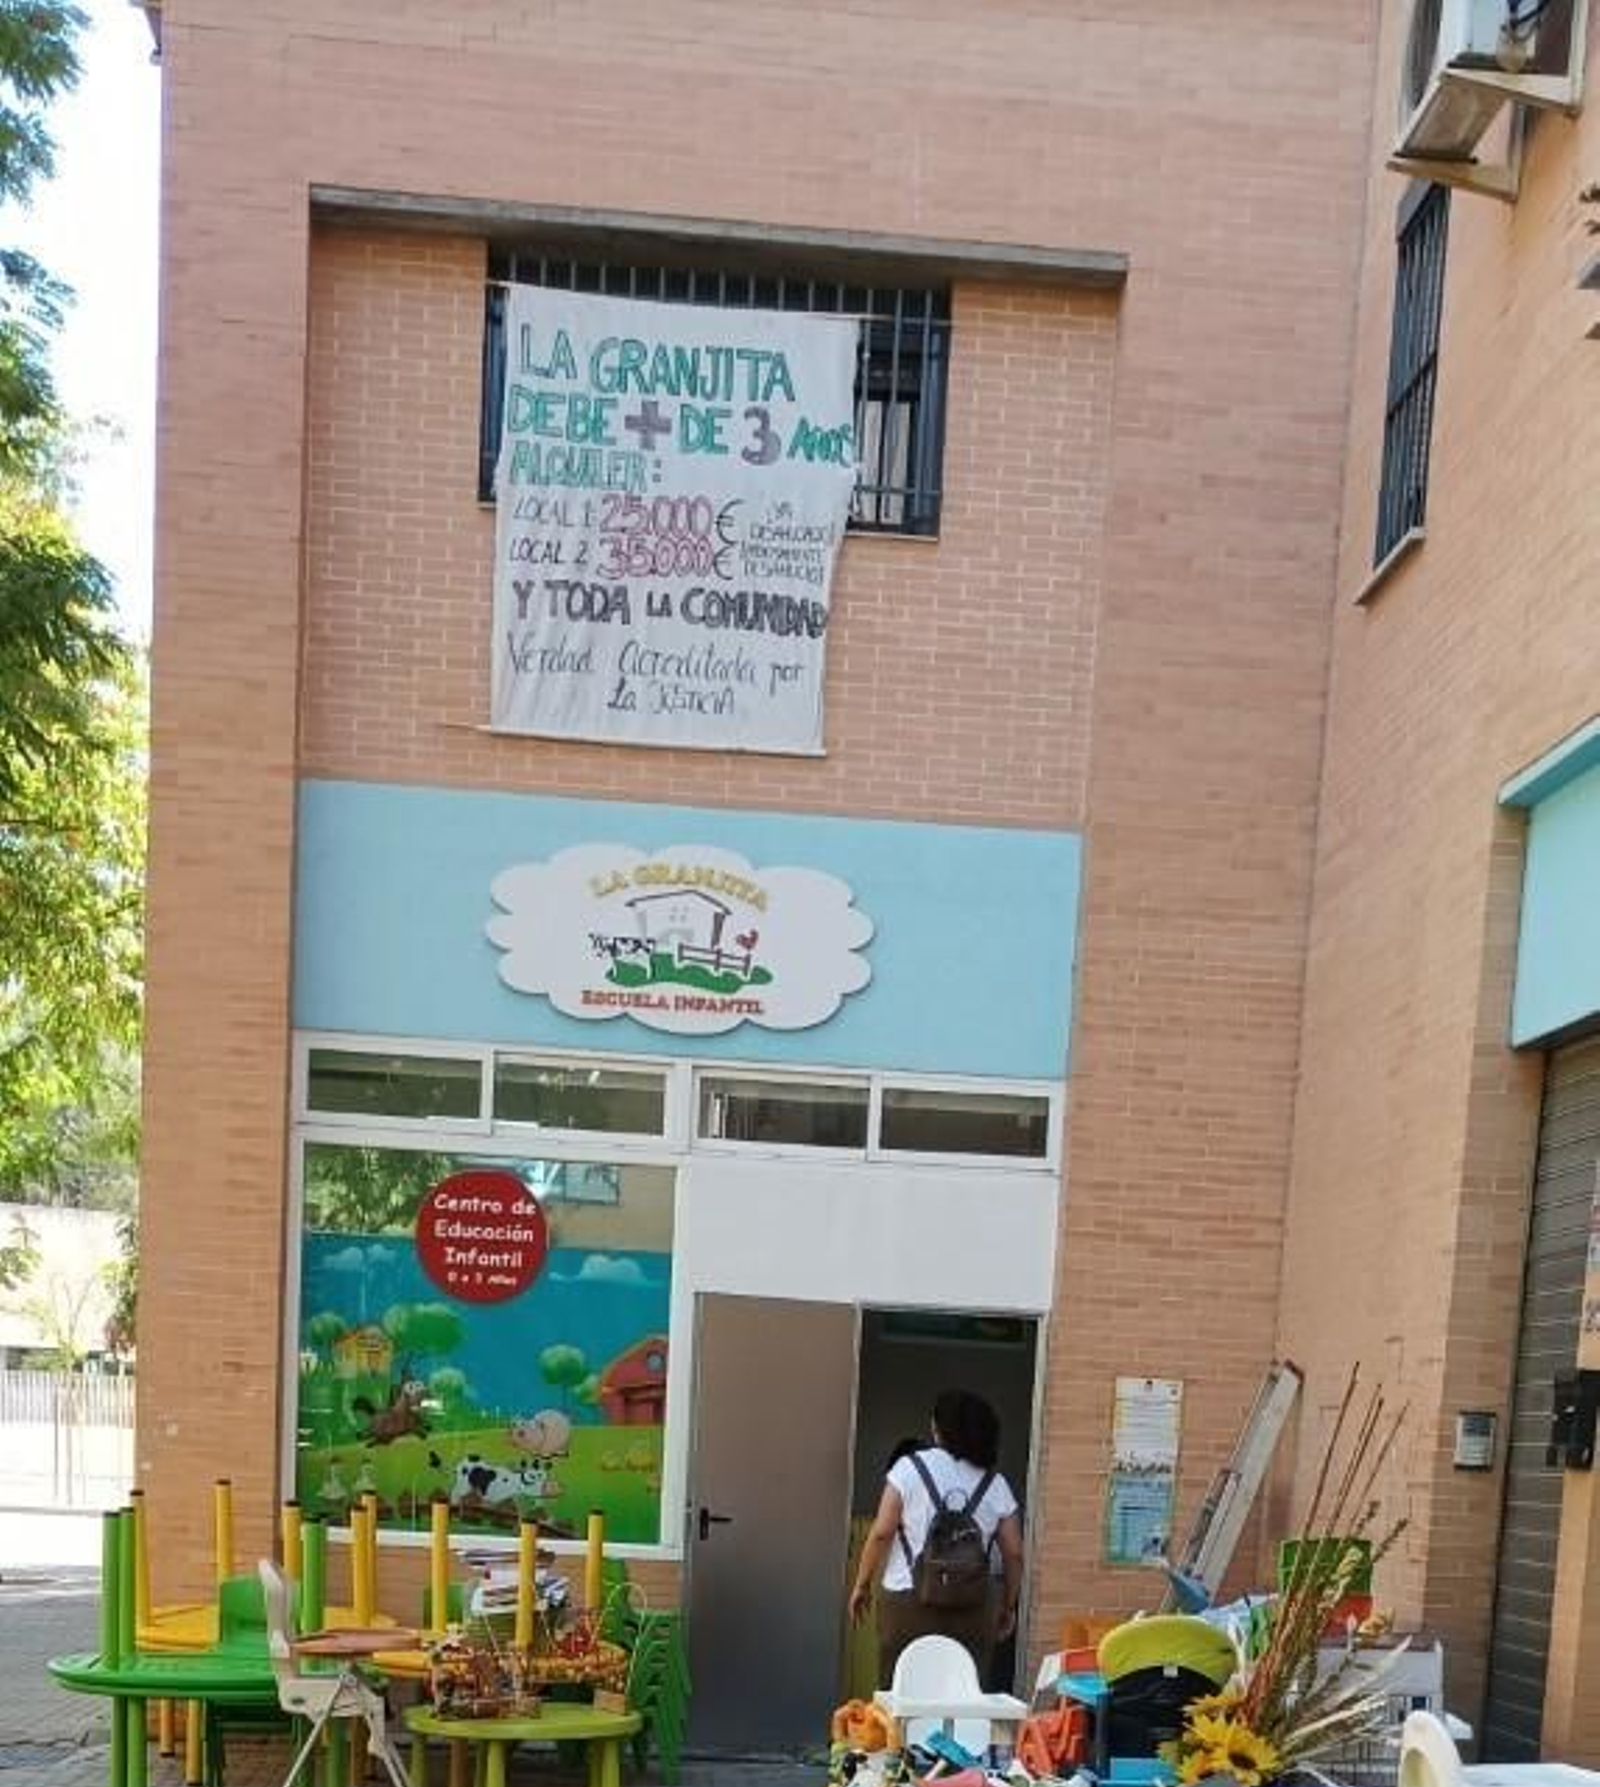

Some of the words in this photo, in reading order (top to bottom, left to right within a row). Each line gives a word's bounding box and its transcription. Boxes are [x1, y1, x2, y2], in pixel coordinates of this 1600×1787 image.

[520, 323, 578, 380] LA
[589, 336, 797, 402] GRANJITA
[506, 385, 620, 447] DEBE
[624, 400, 673, 451] +
[679, 404, 734, 455] DE
[741, 406, 782, 466] 3
[512, 496, 575, 528] LOCAL
[509, 536, 567, 565] LOCAL
[512, 580, 535, 620] Y
[543, 579, 631, 626] TODA
[645, 590, 672, 618] LA
[680, 586, 828, 639] COMUNIDAD
[506, 630, 597, 675] Verdad
[770, 661, 805, 697] por
[588, 870, 630, 897] LA
[633, 862, 769, 914] GRANJITA
[581, 989, 669, 1011] ESCUELA
[673, 994, 766, 1015] INFANTIL
[433, 1193, 503, 1214] Centro
[511, 1199, 537, 1216] de
[433, 1219, 534, 1243] Educación
[444, 1246, 523, 1268] Infantil
